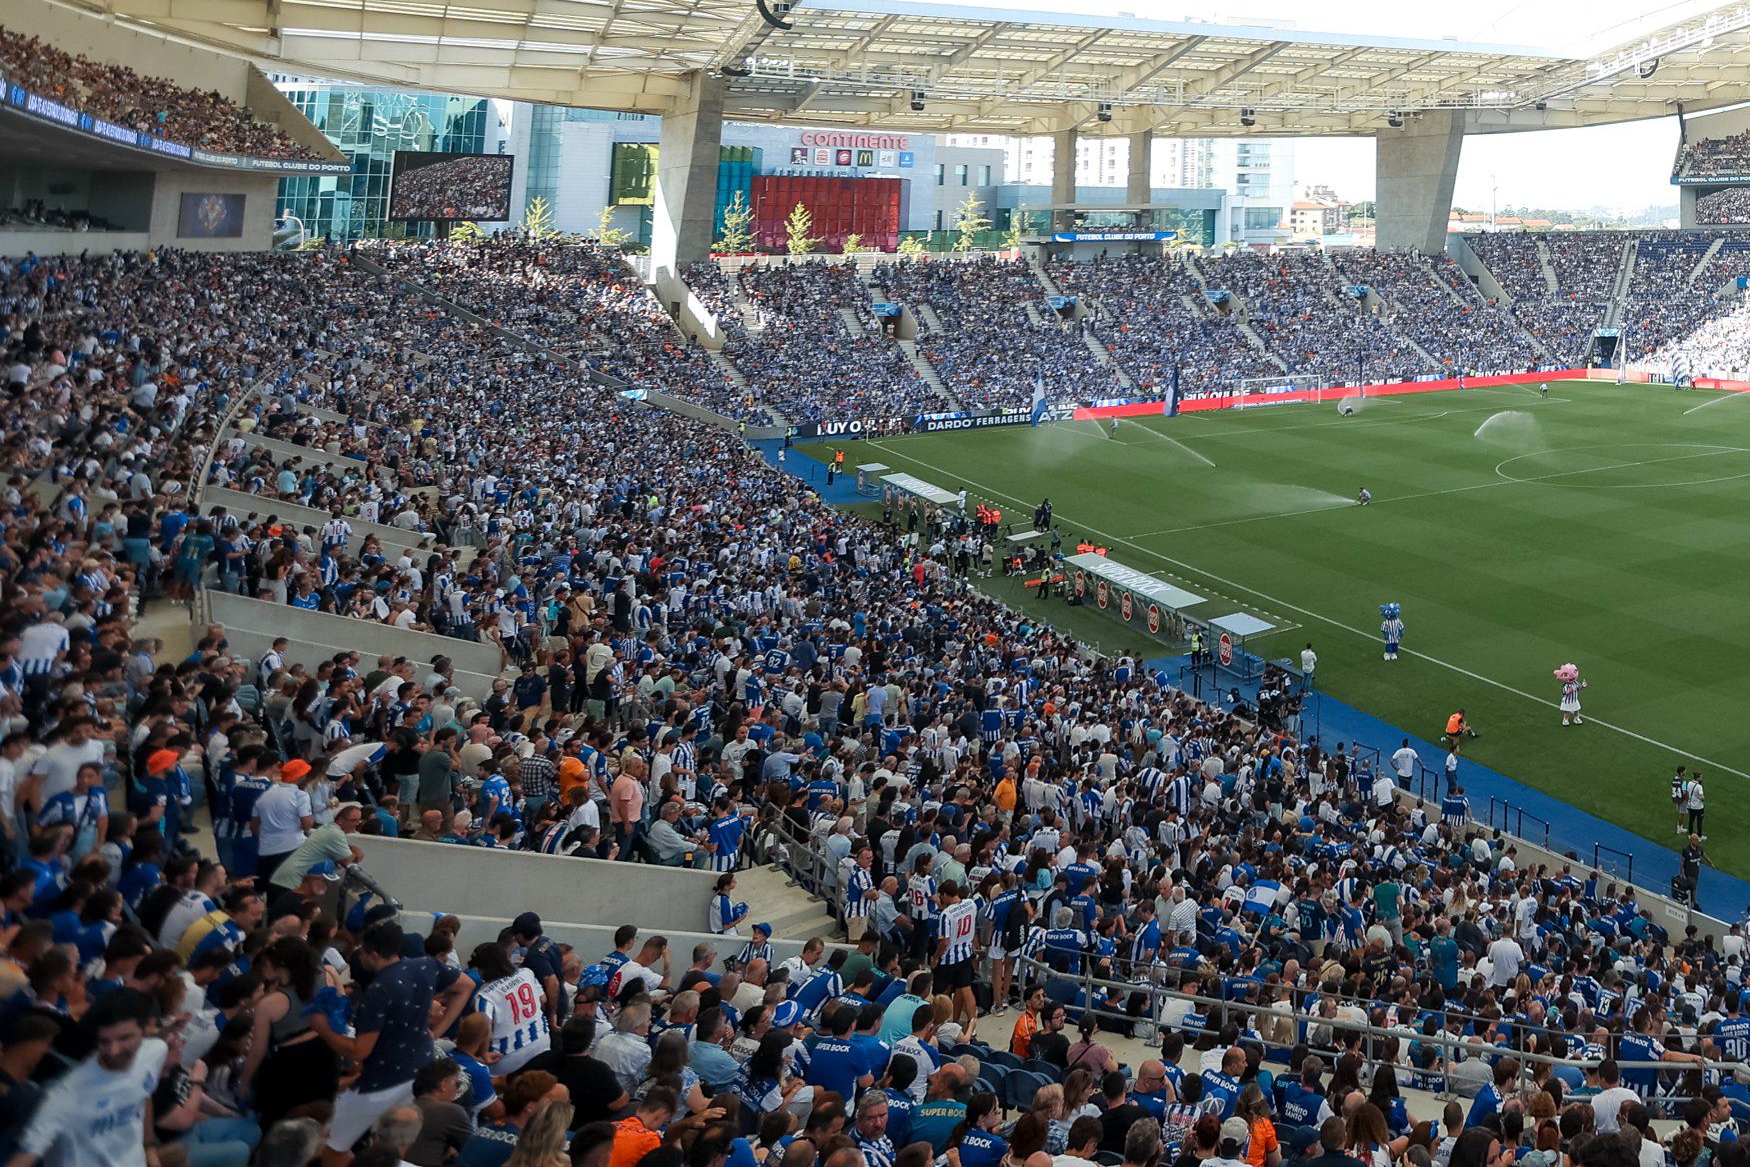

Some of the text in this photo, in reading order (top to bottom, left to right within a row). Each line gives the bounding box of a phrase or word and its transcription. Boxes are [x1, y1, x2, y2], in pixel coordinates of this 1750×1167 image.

[801, 131, 911, 150] CONTINENTE
[252, 159, 282, 169] FUTEBOL
[283, 162, 308, 171] CLUBE
[321, 164, 351, 172] PORTO
[1076, 233, 1103, 241] FUTEBOL
[1104, 233, 1124, 241] CLUBE
[1134, 232, 1156, 240] PORTO
[976, 413, 1032, 427] FERRAGENS
[330, 523, 343, 536] 10
[768, 655, 781, 669] 82
[955, 914, 974, 939] 10
[505, 983, 537, 1025] 19
[1721, 1022, 1750, 1033] SUPER BOCK
[816, 1042, 851, 1053] SUPER BOCK
[1203, 1070, 1238, 1094] SUPER BOCK
[888, 1098, 911, 1111] BOCK
[920, 1108, 947, 1117] SUPER
[1284, 1108, 1303, 1122] SANTO
[968, 1136, 992, 1150] BOCK
